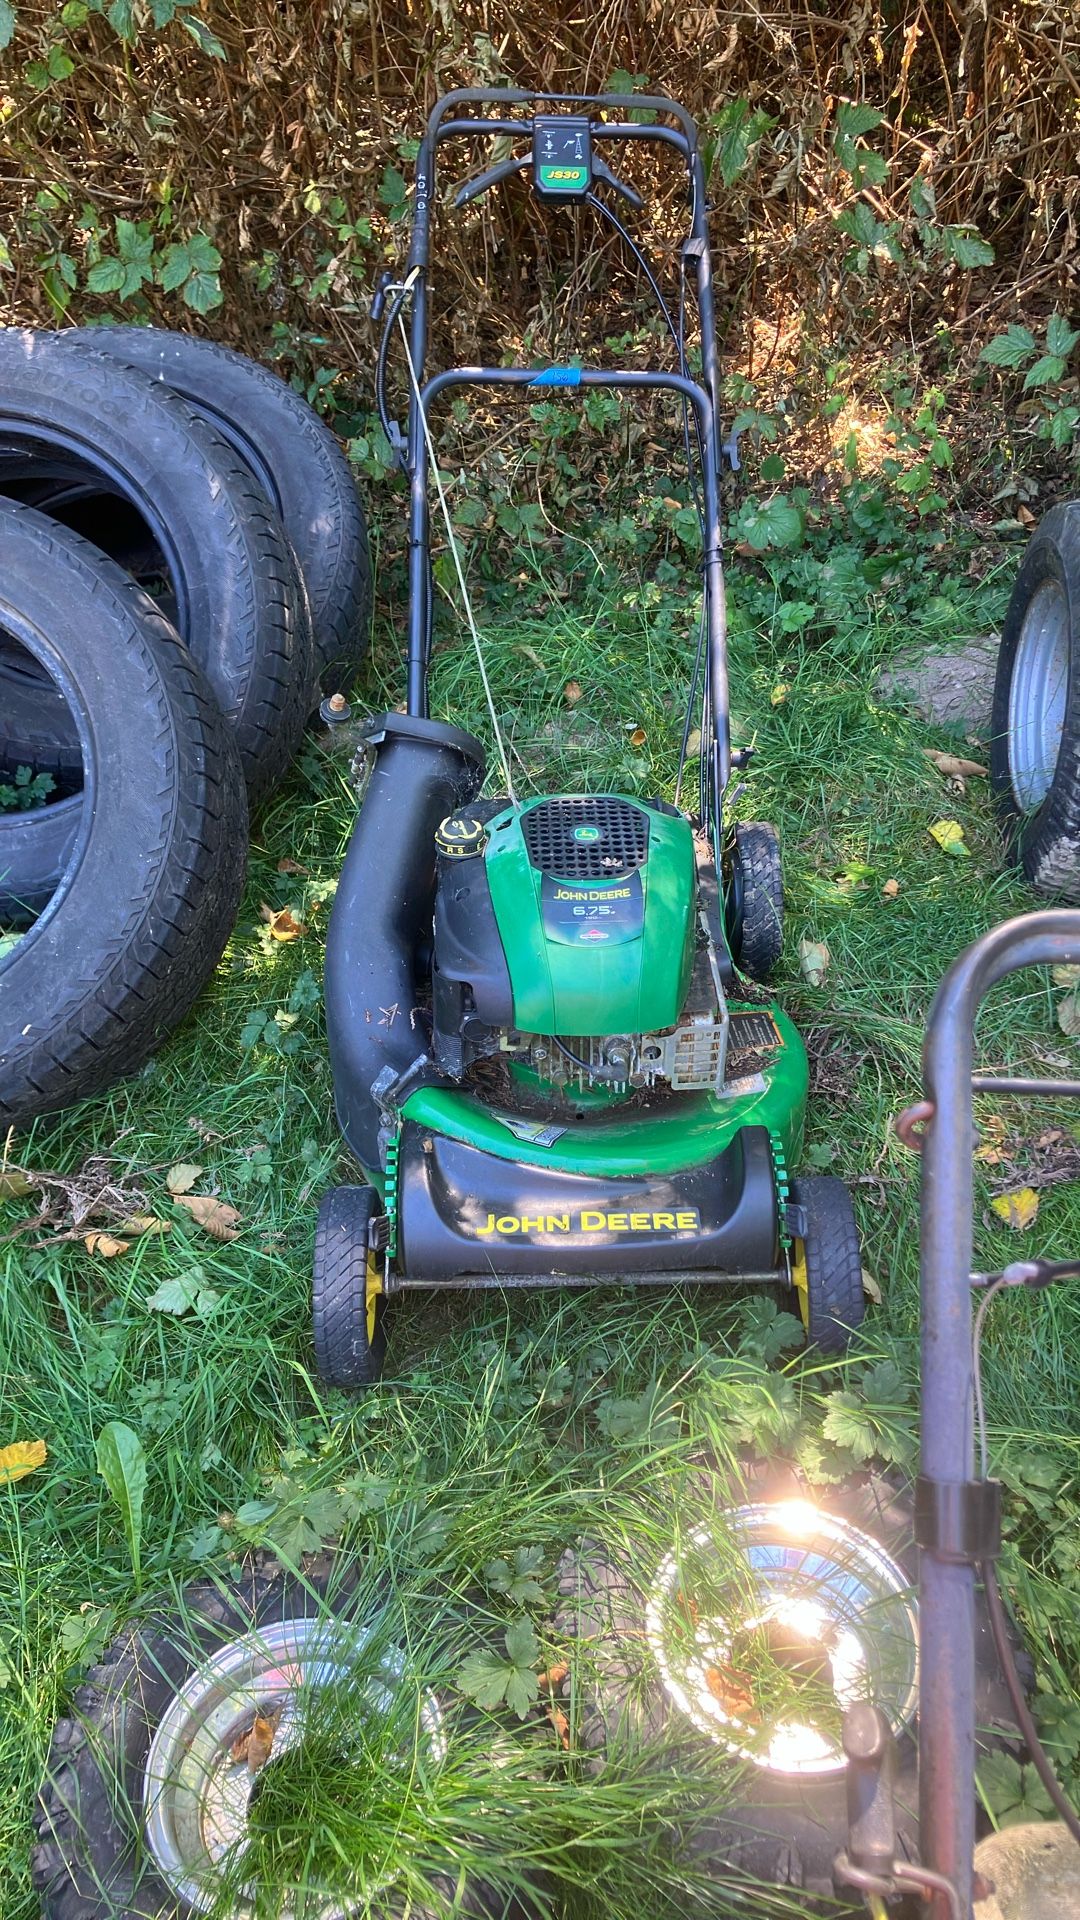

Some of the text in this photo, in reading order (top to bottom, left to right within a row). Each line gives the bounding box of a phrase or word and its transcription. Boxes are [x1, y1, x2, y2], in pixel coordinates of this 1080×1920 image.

[547, 170, 581, 180] JS30
[553, 888, 631, 901] JOHN DEERE
[476, 1211, 698, 1234] JOHN DEERE
